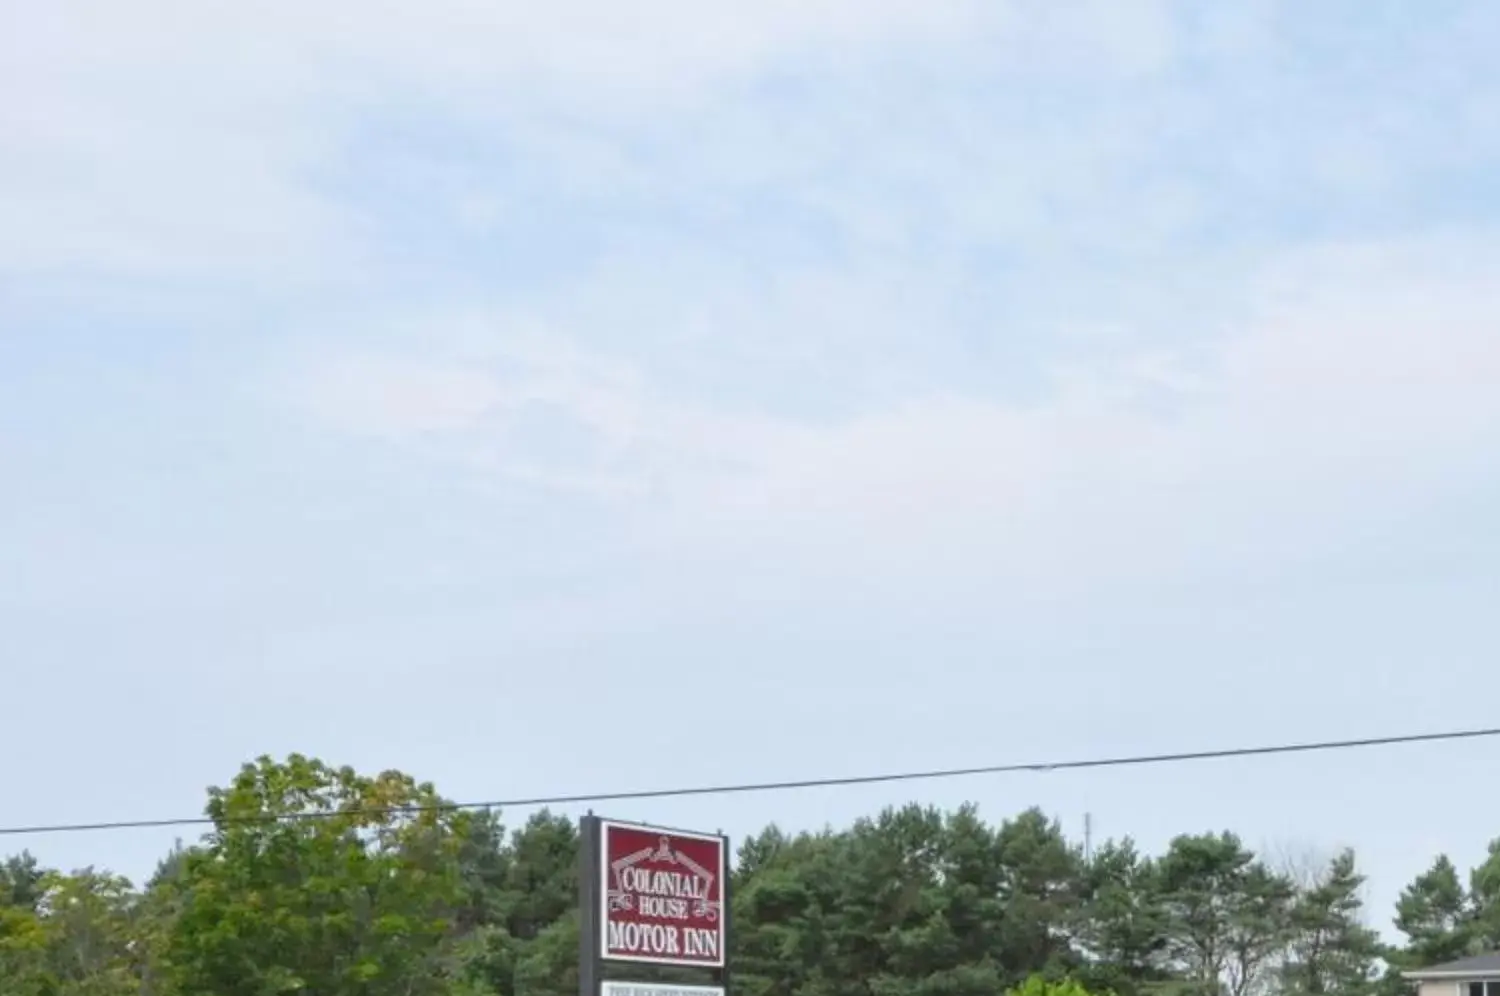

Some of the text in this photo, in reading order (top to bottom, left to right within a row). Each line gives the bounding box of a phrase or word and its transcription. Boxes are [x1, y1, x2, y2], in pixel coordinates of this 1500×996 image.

[623, 866, 704, 899] COLONIAL
[639, 895, 688, 919] HOUSE
[608, 920, 717, 956] MOTOR INN
